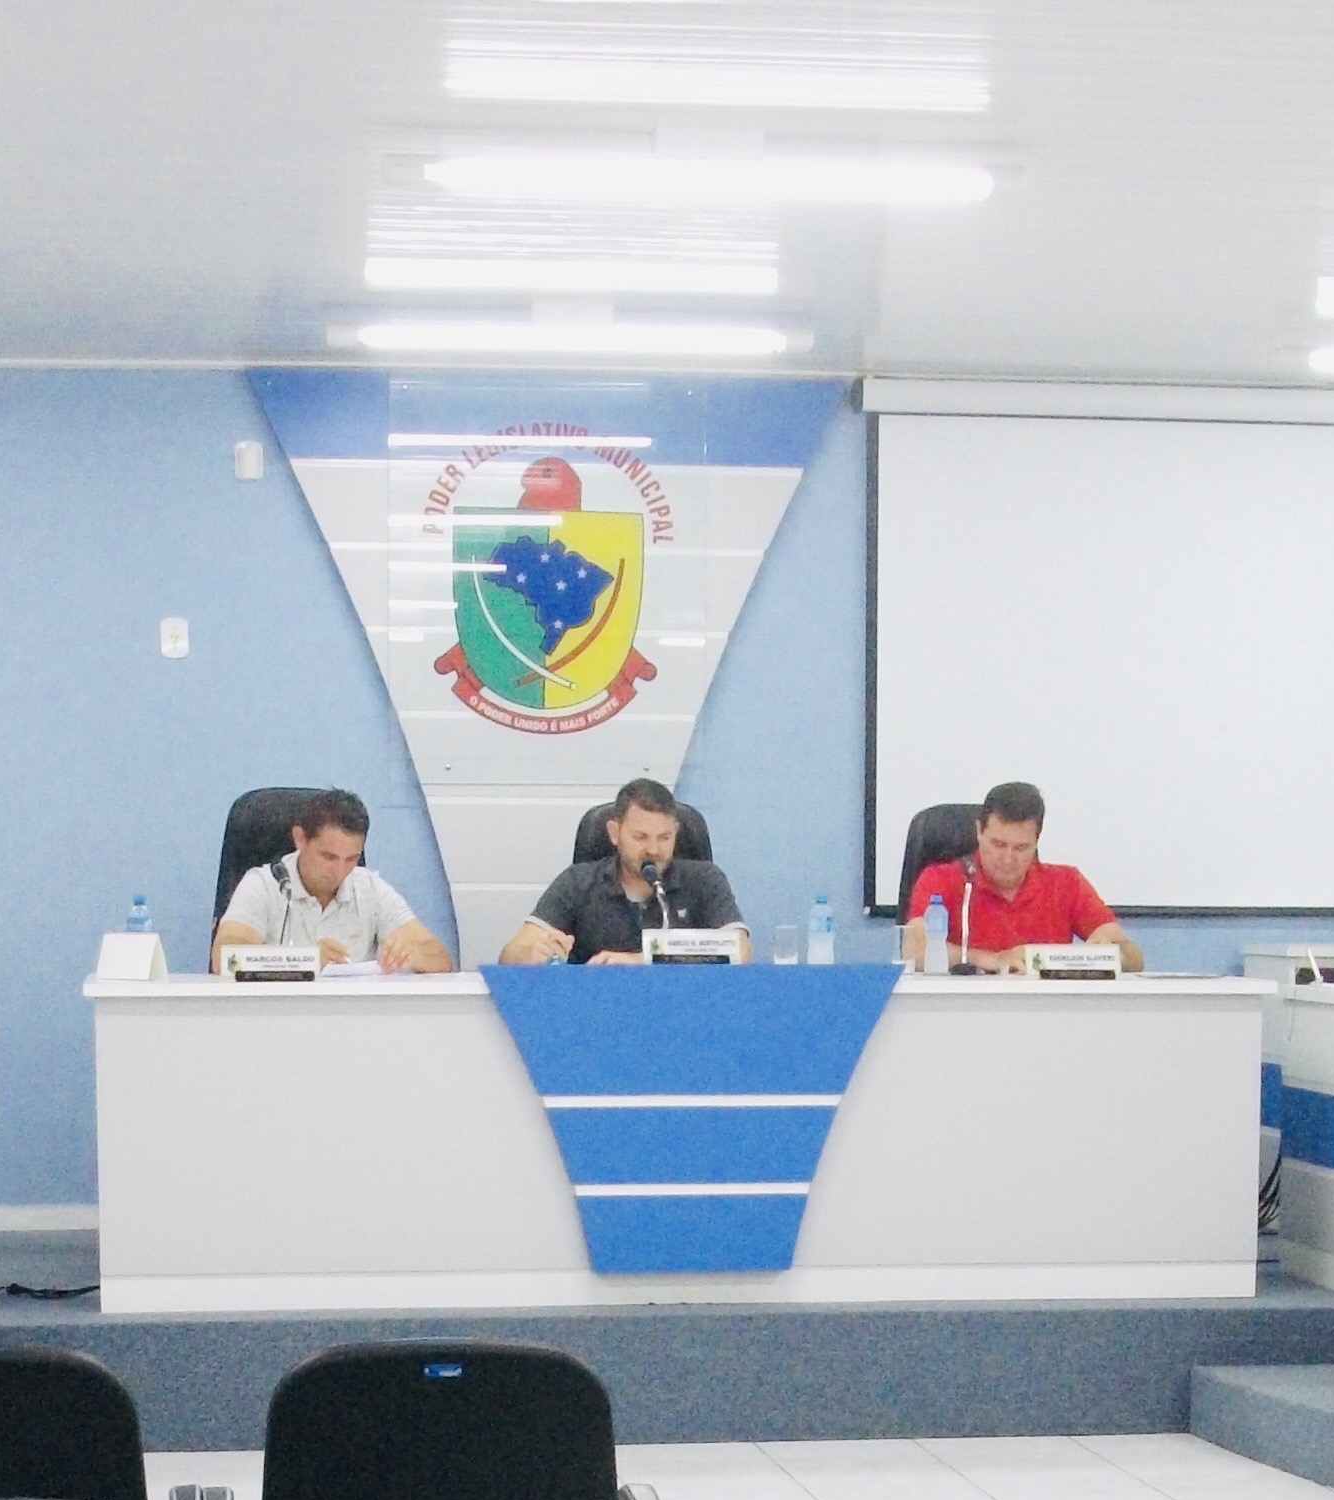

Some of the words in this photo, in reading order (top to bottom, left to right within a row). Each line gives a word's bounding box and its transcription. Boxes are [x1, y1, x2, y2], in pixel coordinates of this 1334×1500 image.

[593, 445, 674, 545] MUNICIPAL
[478, 702, 513, 726] PODER
[513, 717, 548, 731] UNIDO
[560, 716, 587, 731] MAIS
[586, 696, 620, 723] FORTE
[246, 955, 283, 963] MARCOS
